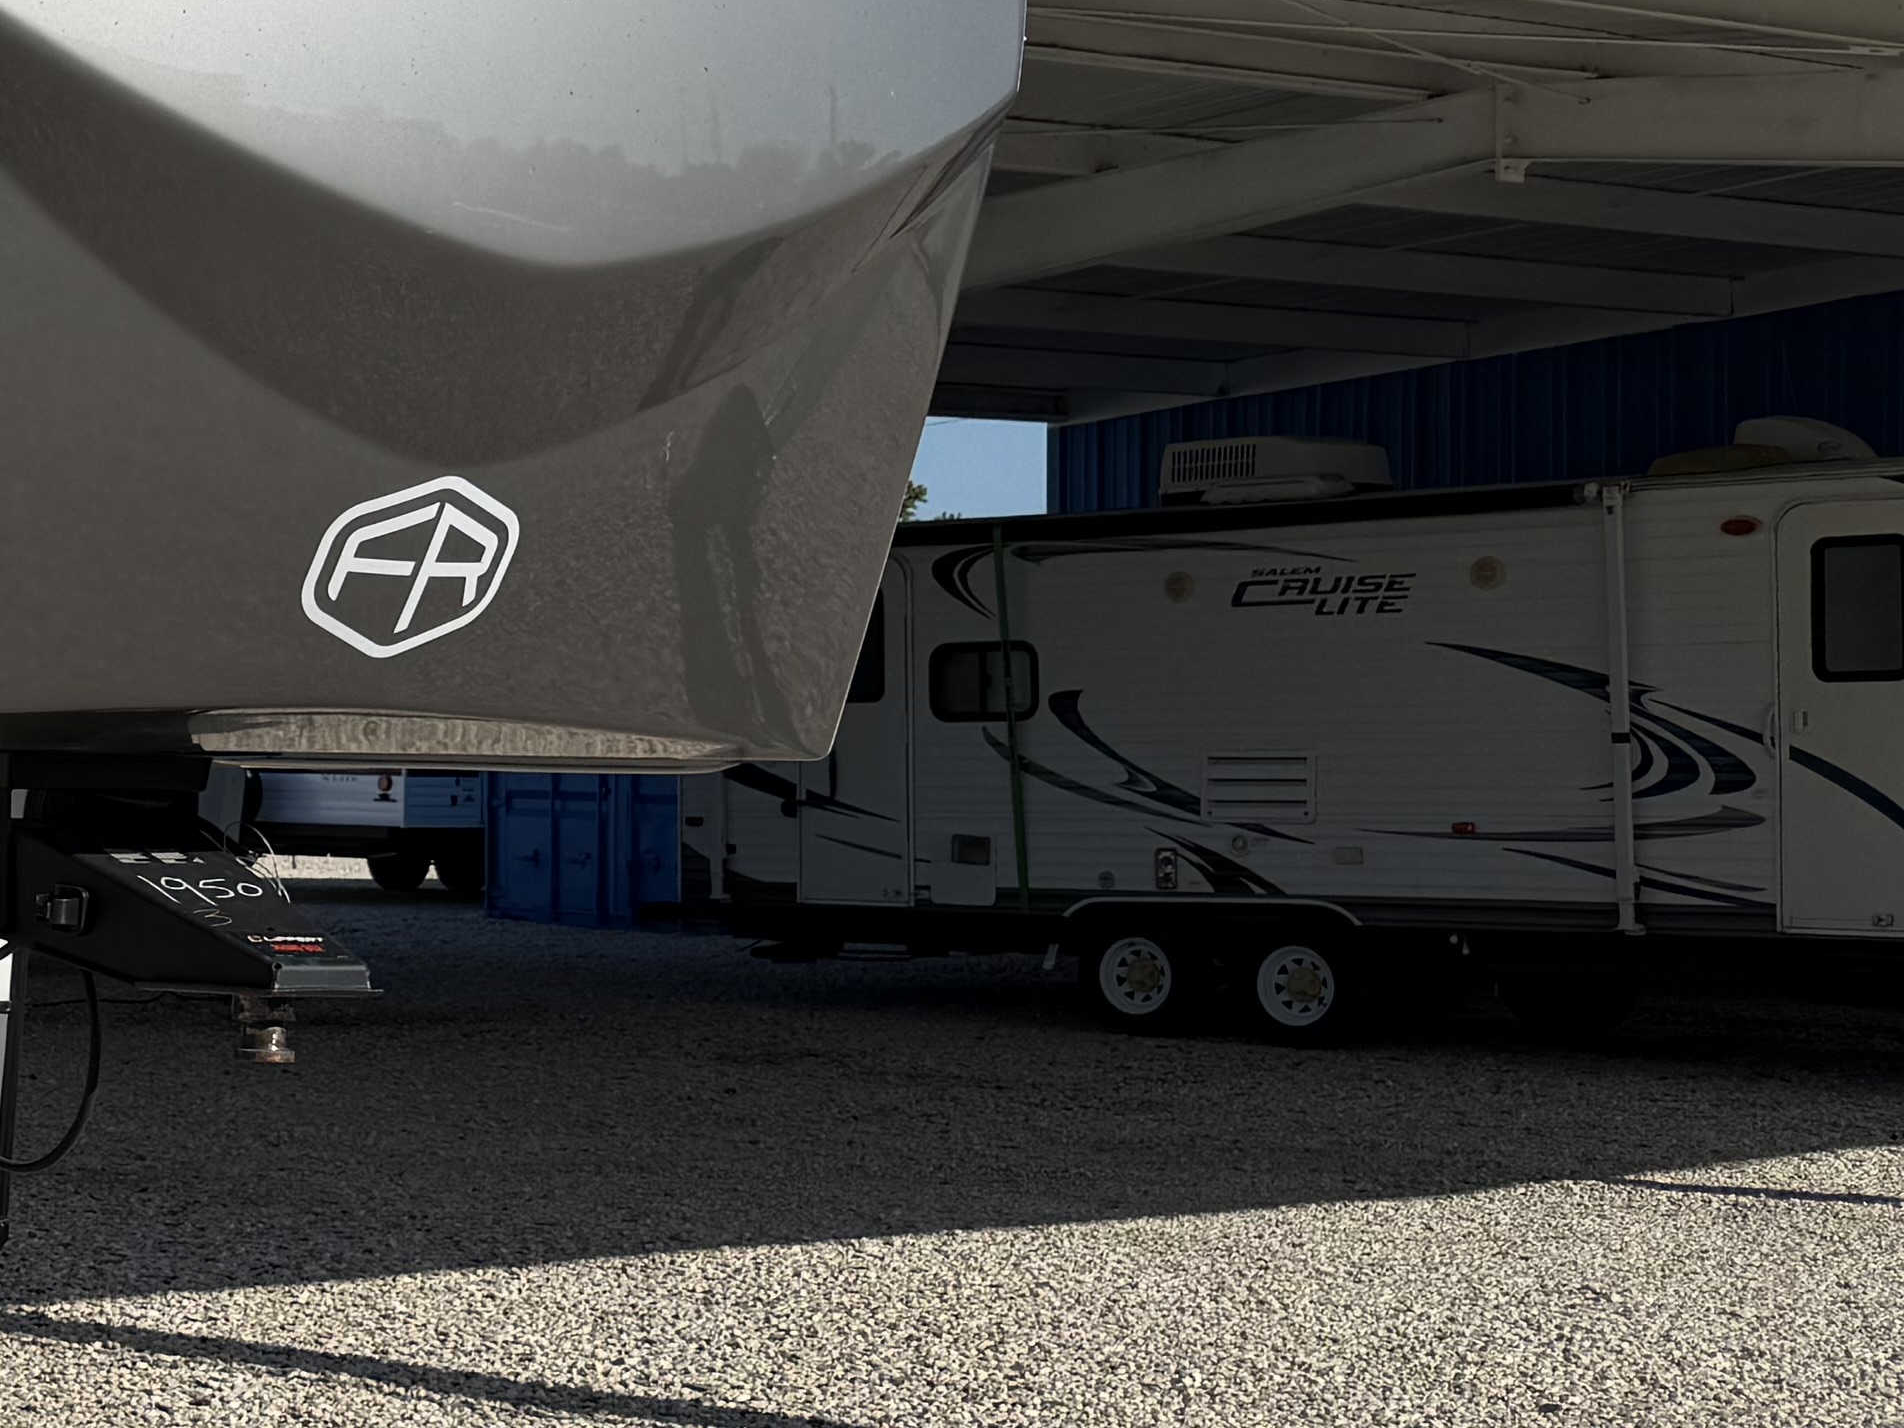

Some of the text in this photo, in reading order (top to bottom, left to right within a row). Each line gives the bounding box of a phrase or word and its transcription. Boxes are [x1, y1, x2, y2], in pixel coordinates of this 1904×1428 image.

[1250, 566, 1322, 578] SALEM
[1230, 572, 1417, 608] CRUISE
[1314, 594, 1409, 616] LITE
[136, 873, 264, 907] 1950
